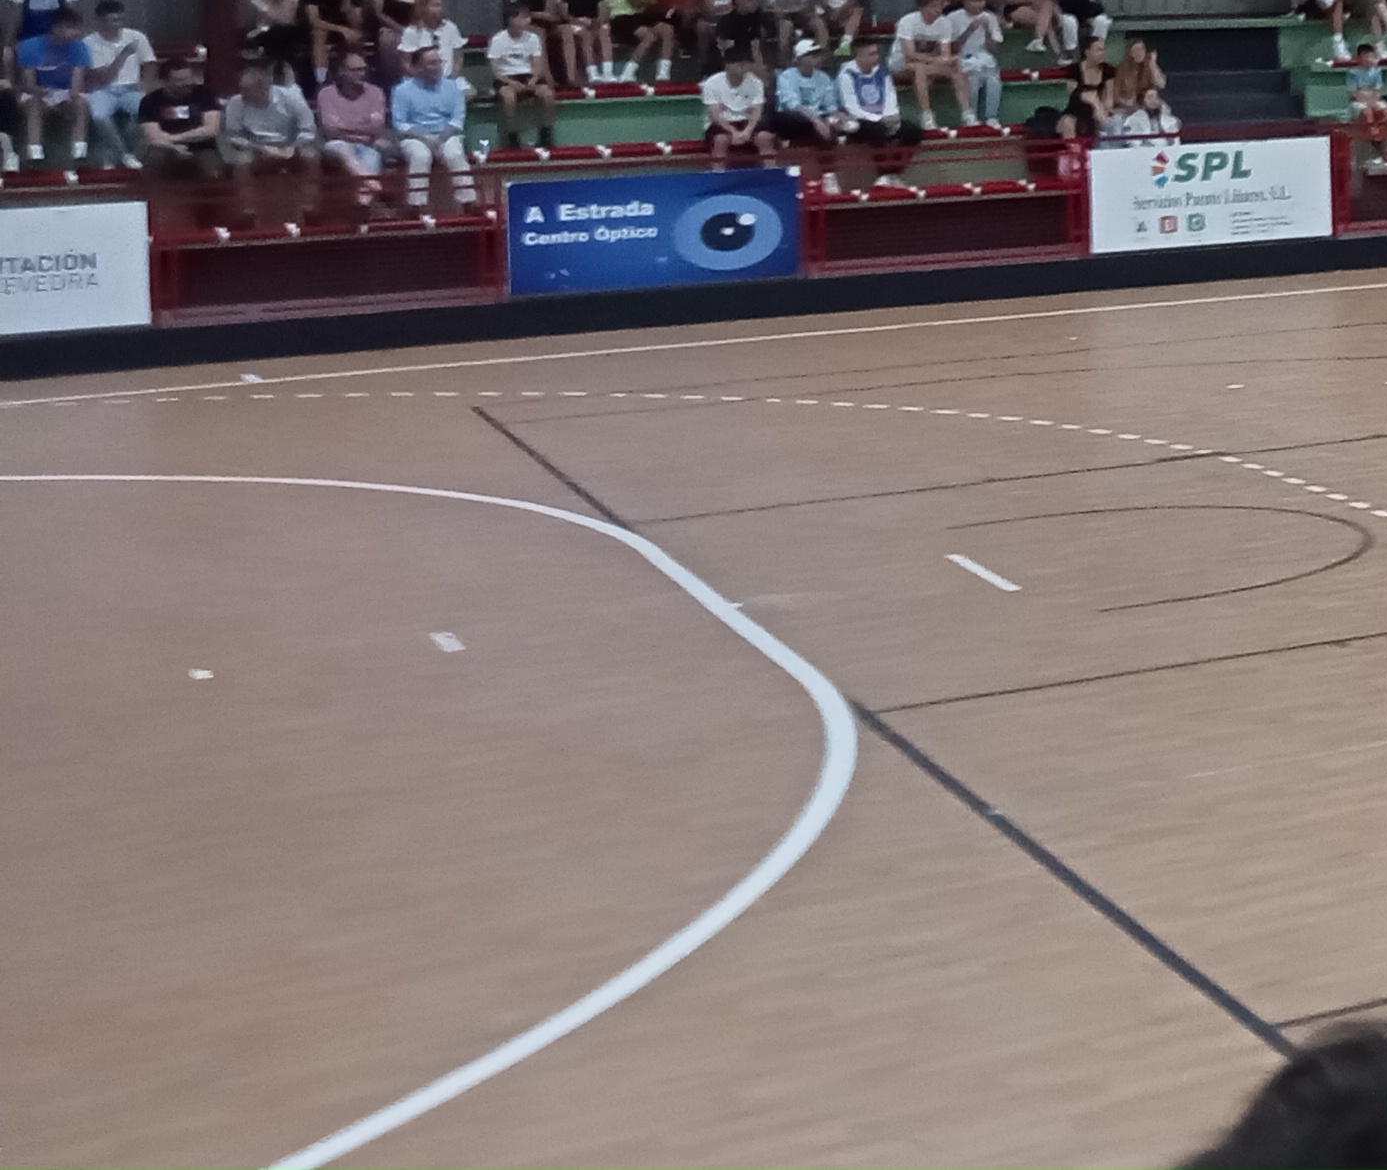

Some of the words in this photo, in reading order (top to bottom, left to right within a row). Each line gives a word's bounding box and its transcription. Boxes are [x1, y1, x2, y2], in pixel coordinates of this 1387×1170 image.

[1172, 150, 1253, 182] SPL
[524, 206, 546, 224] A
[558, 199, 656, 222] Estrada
[521, 231, 590, 246] Centro
[593, 224, 659, 244] Óptico
[0, 249, 98, 275] TACIÓN
